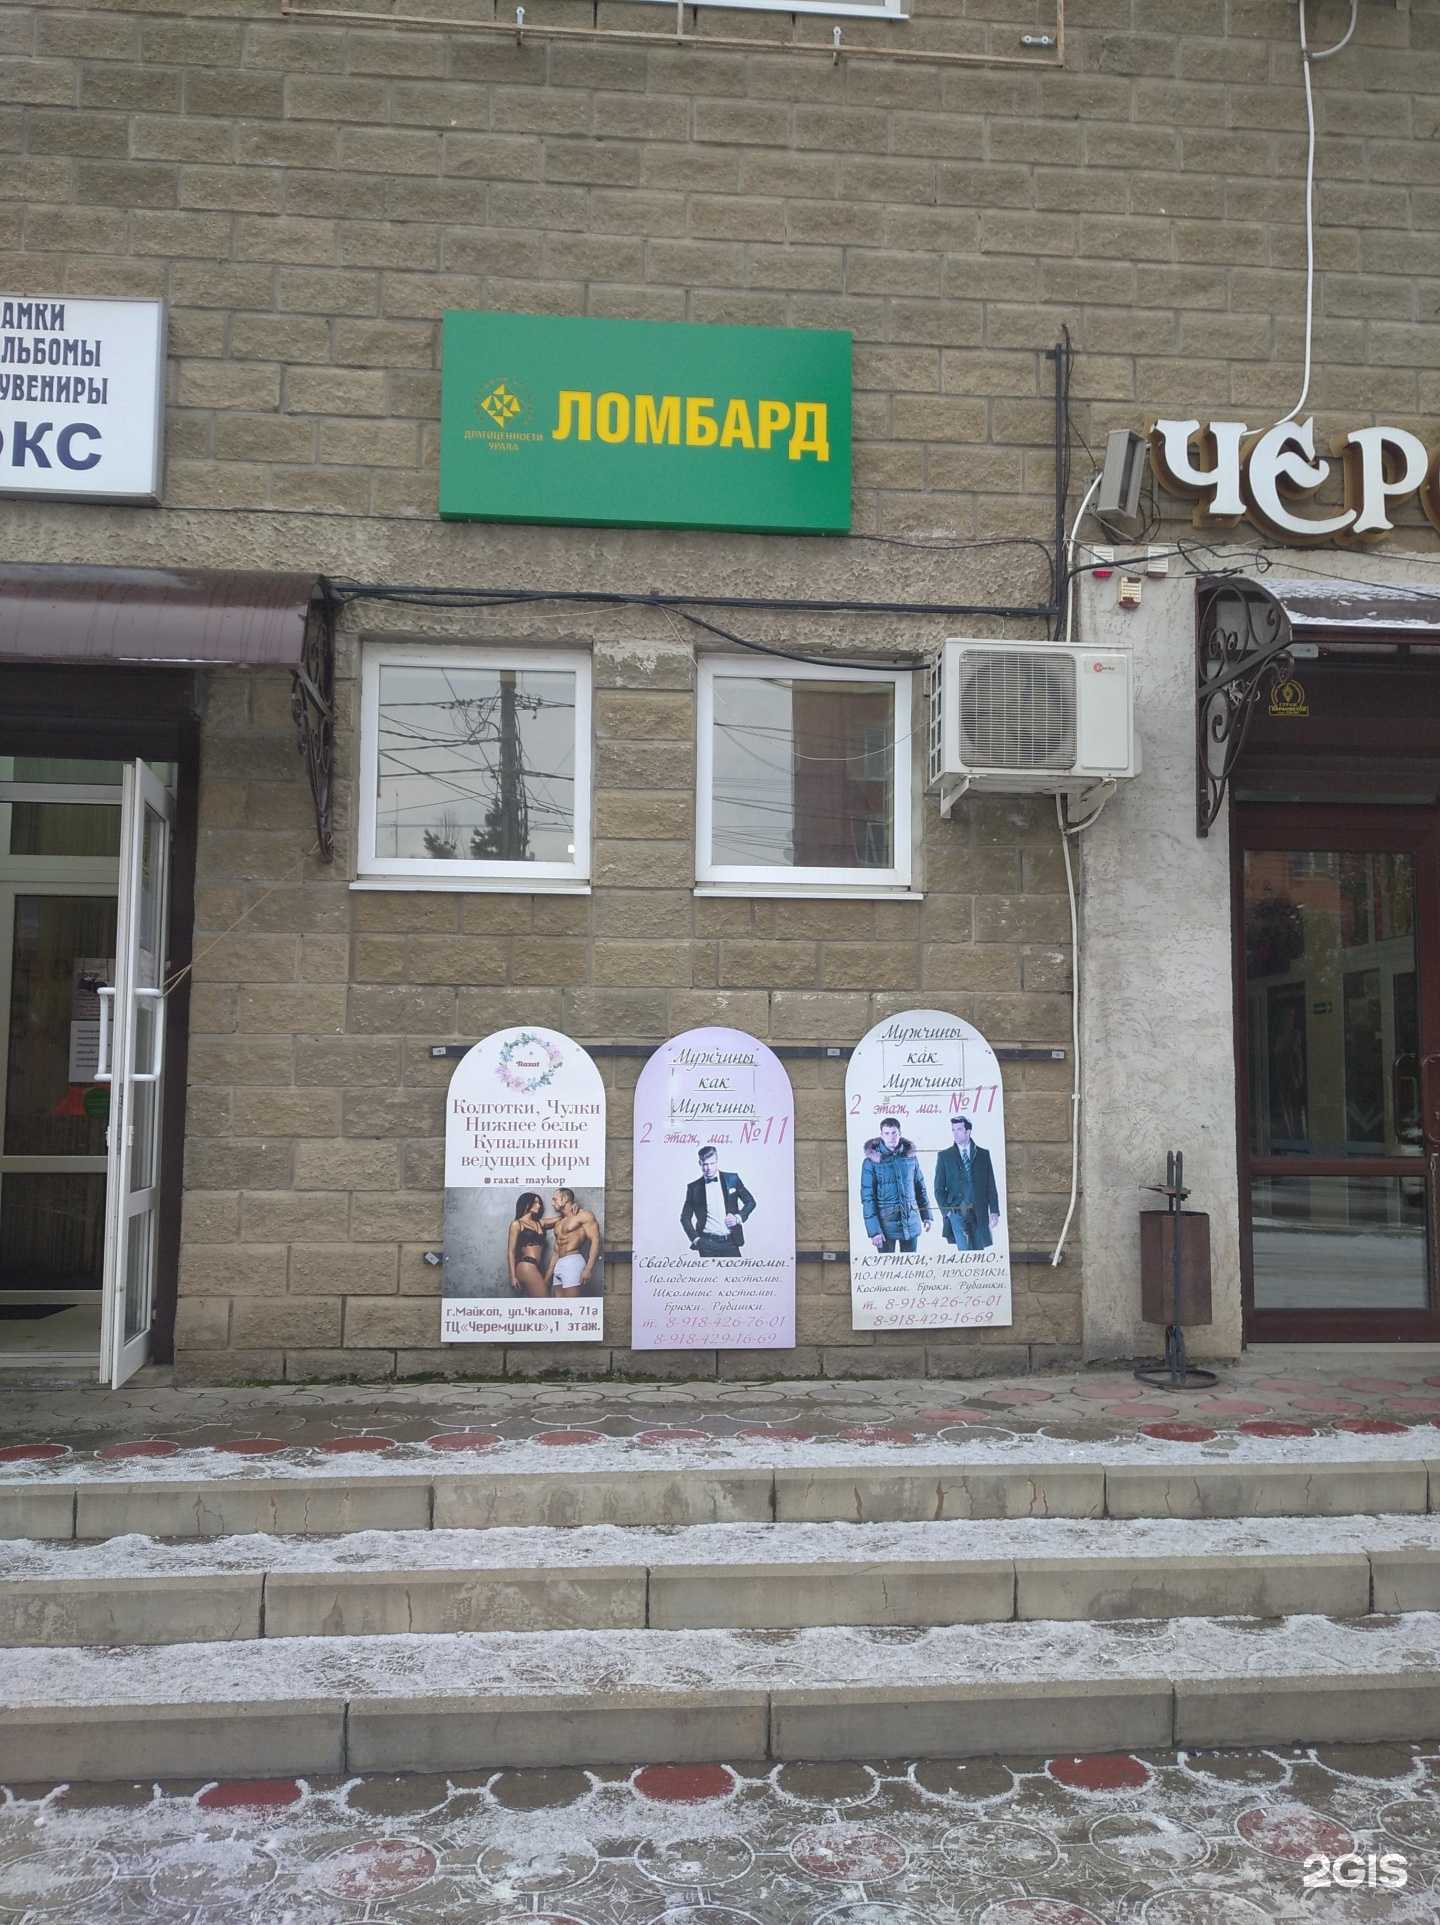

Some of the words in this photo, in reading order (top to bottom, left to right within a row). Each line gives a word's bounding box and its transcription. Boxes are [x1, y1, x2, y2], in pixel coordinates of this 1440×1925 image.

[0, 302, 65, 331] АМКИ
[1, 336, 101, 367] ЛЬБОМЫ
[0, 373, 108, 405] УВЕНИРЫ
[552, 390, 830, 462] ЛОМБАРД
[0, 420, 102, 471] КС
[1151, 416, 1440, 535] ЧЕР
[881, 1024, 962, 1047] Мужчины
[673, 1048, 757, 1071] Мужчины
[907, 1050, 939, 1064] как
[698, 1077, 730, 1089] как
[882, 1073, 964, 1096] Мужчины
[453, 1099, 540, 1116] Колготки,
[547, 1099, 600, 1118] Чулки
[672, 1099, 757, 1121] Мужчины
[850, 1094, 862, 1115] 2
[873, 1103, 909, 1117] этаж,
[949, 1085, 998, 1113] №11
[466, 1117, 536, 1132] Нижнее
[541, 1117, 588, 1132] белье
[640, 1122, 653, 1144] 2
[663, 1132, 701, 1146] этаж,
[739, 1116, 789, 1145] №11
[474, 1134, 578, 1152] Купальники
[461, 1156, 535, 1170] ведущих
[541, 1153, 590, 1170] фирм
[638, 1255, 712, 1269] Свадебные
[652, 1287, 713, 1298] Школьные
[579, 1306, 599, 1316] 71а
[568, 1321, 601, 1332] этаж.
